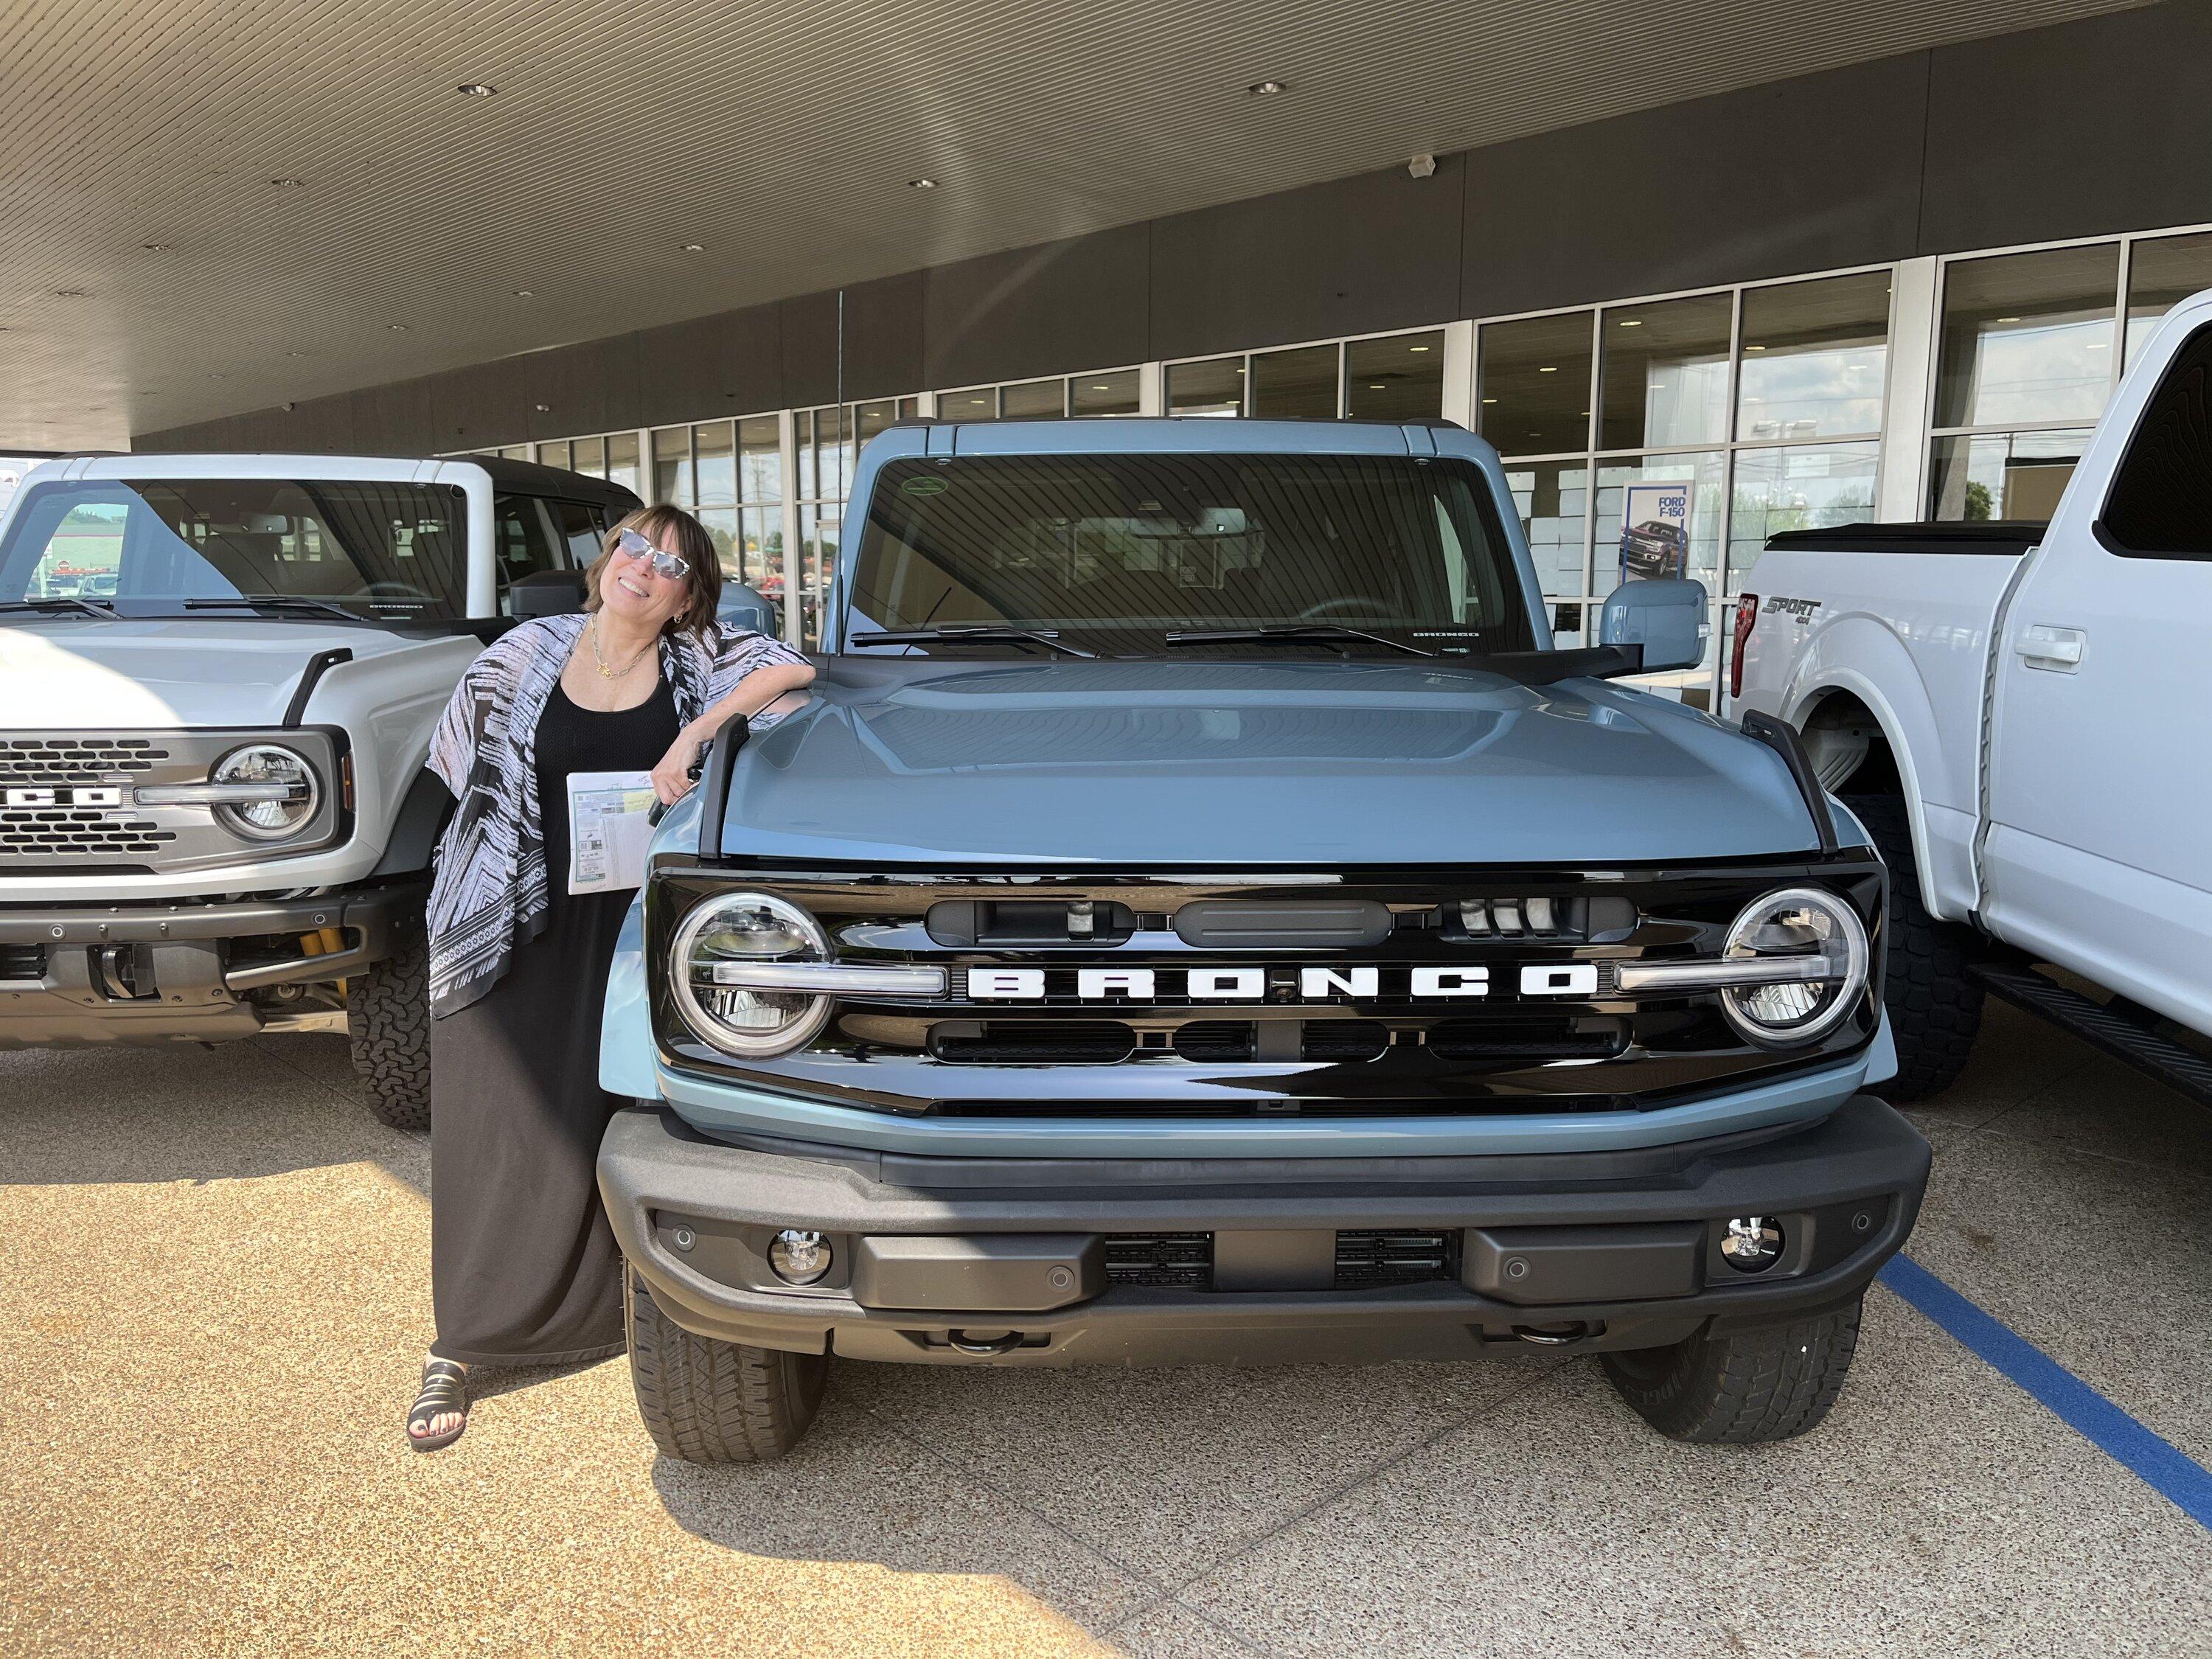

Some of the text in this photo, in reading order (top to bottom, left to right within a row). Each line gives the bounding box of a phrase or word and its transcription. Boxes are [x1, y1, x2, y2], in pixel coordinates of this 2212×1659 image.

[1658, 497, 1686, 507] FORD
[1659, 507, 1686, 518] F-150
[1761, 596, 1822, 616] SPORT
[967, 966, 1599, 998] BRONCO
